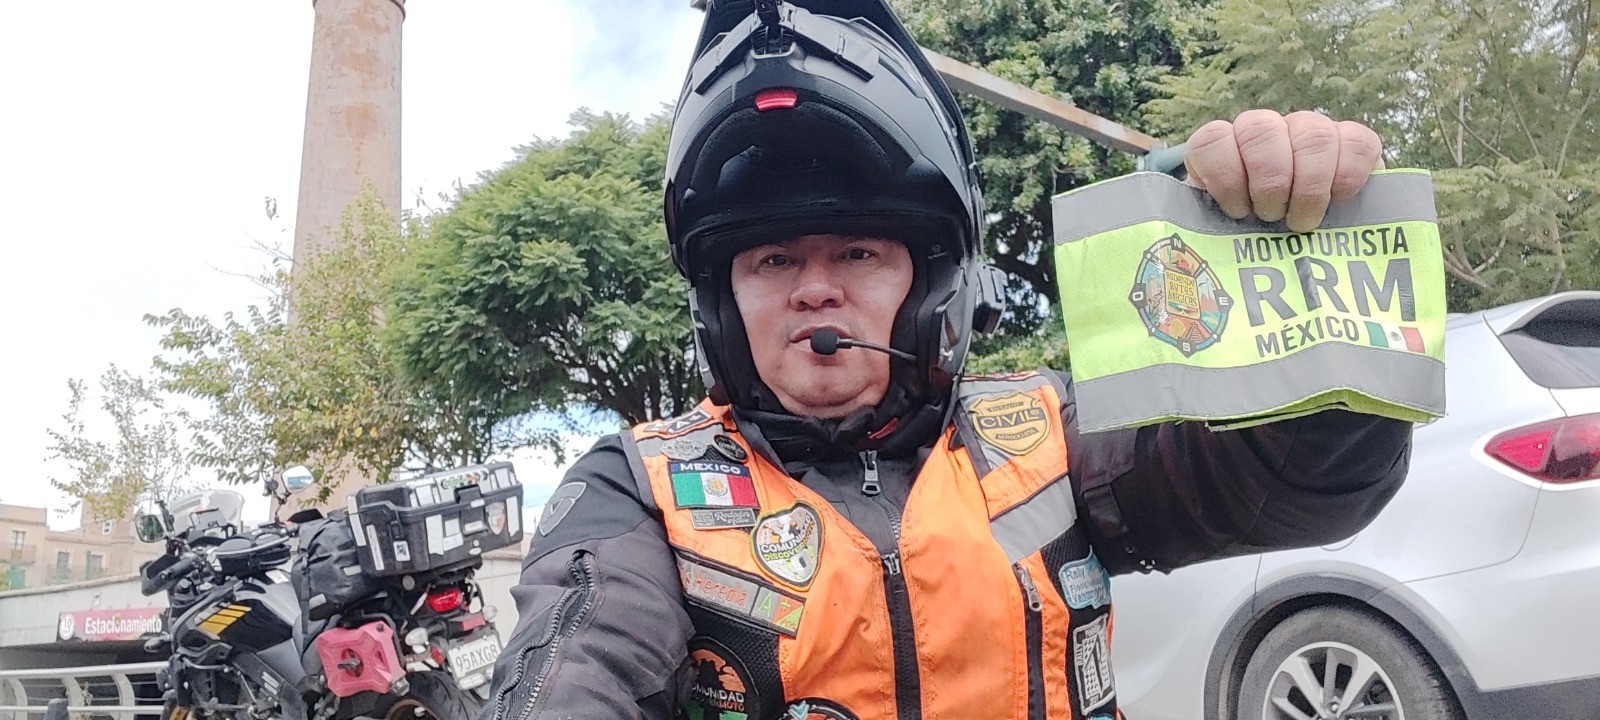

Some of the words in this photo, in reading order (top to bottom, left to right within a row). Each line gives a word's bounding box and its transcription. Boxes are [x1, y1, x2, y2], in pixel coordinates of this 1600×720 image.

[1173, 238, 1182, 248] N
[1233, 226, 1409, 264] MOTOTURISTA
[1132, 291, 1144, 301] O
[1219, 296, 1229, 306] E
[1238, 256, 1416, 327] RRM
[1182, 342, 1191, 352] S
[1255, 316, 1359, 358] MÉXICO
[680, 462, 741, 475] MEXICO
[761, 515, 811, 553] COMUNIDAD
[85, 615, 162, 635] Estacionamiento
[455, 644, 499, 671] 95AXG8
